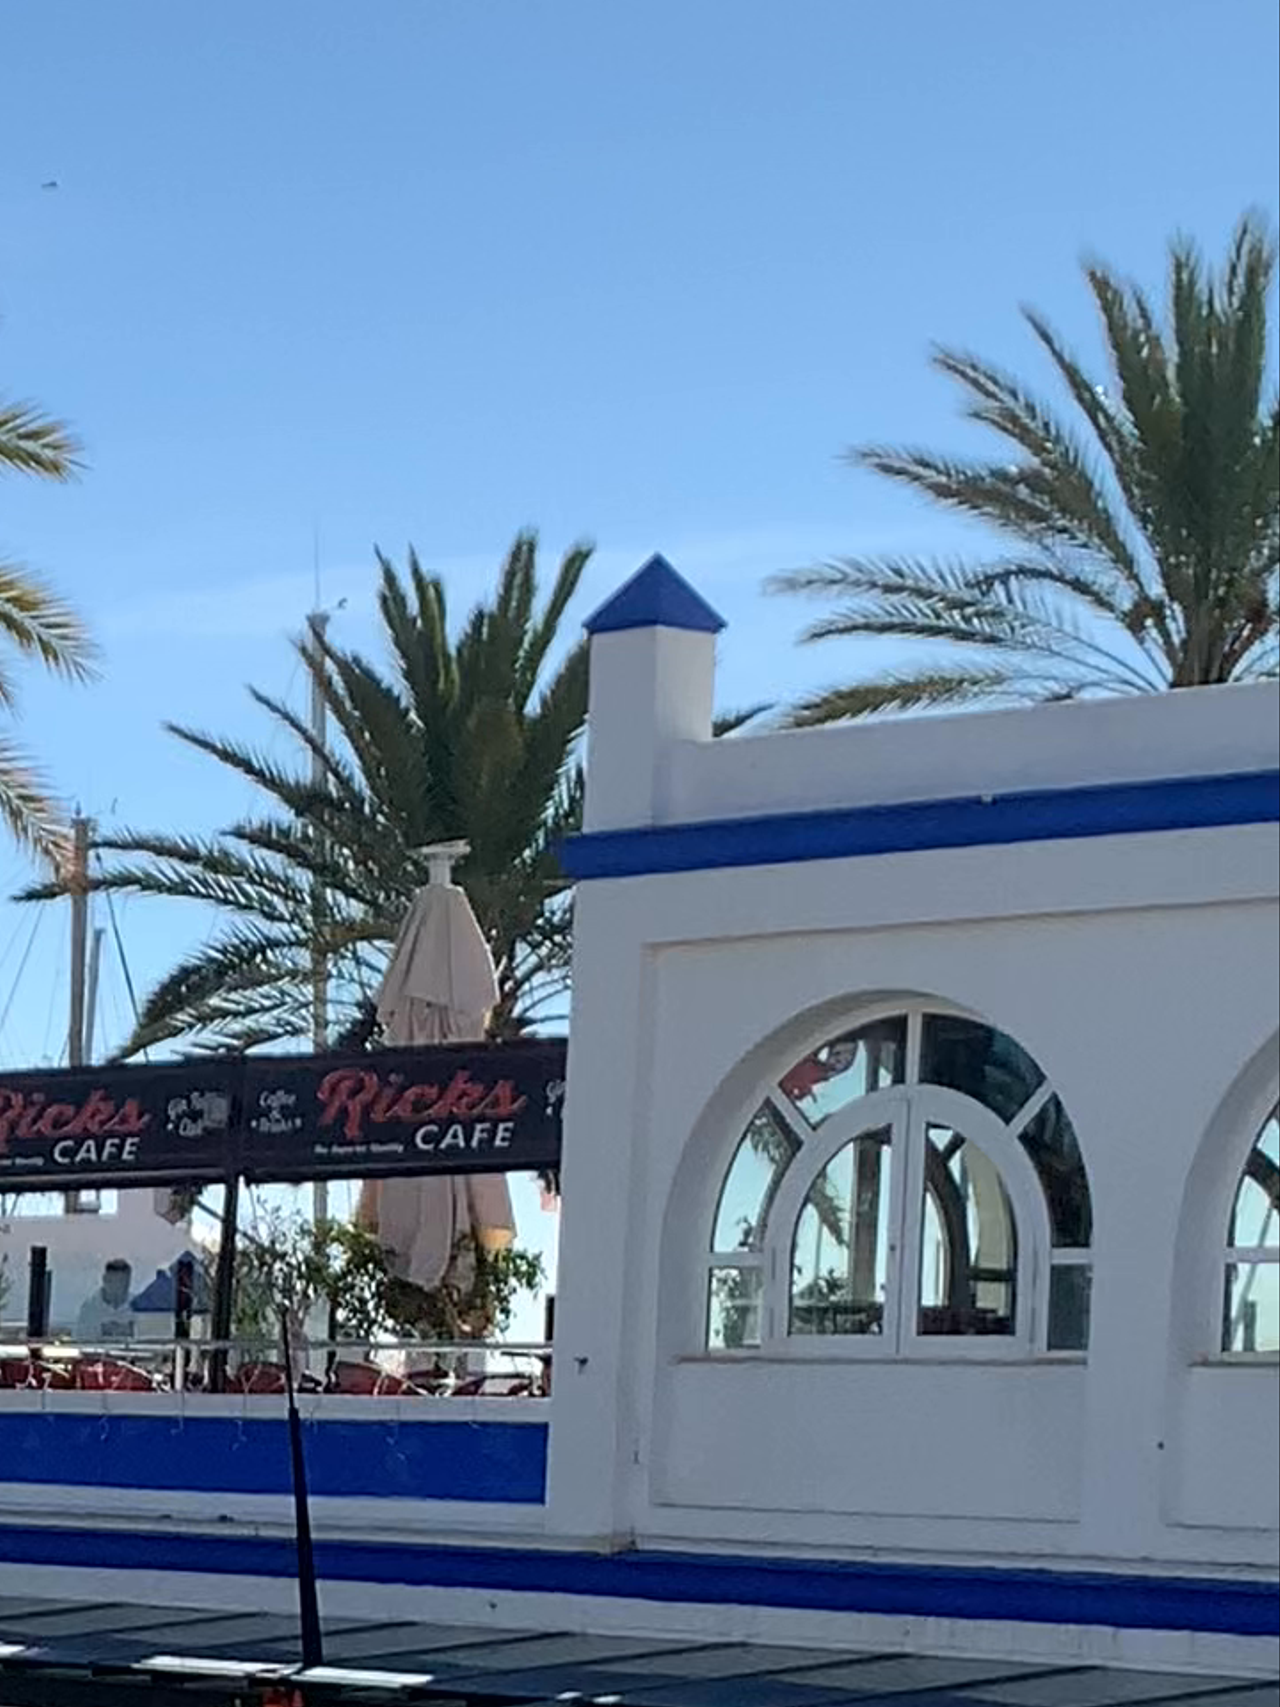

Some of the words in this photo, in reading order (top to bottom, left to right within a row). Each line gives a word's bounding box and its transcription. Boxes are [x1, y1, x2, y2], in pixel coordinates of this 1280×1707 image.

[317, 1067, 527, 1140] Ricks
[415, 1121, 515, 1150] CAFE
[53, 1137, 140, 1164] CAFE
